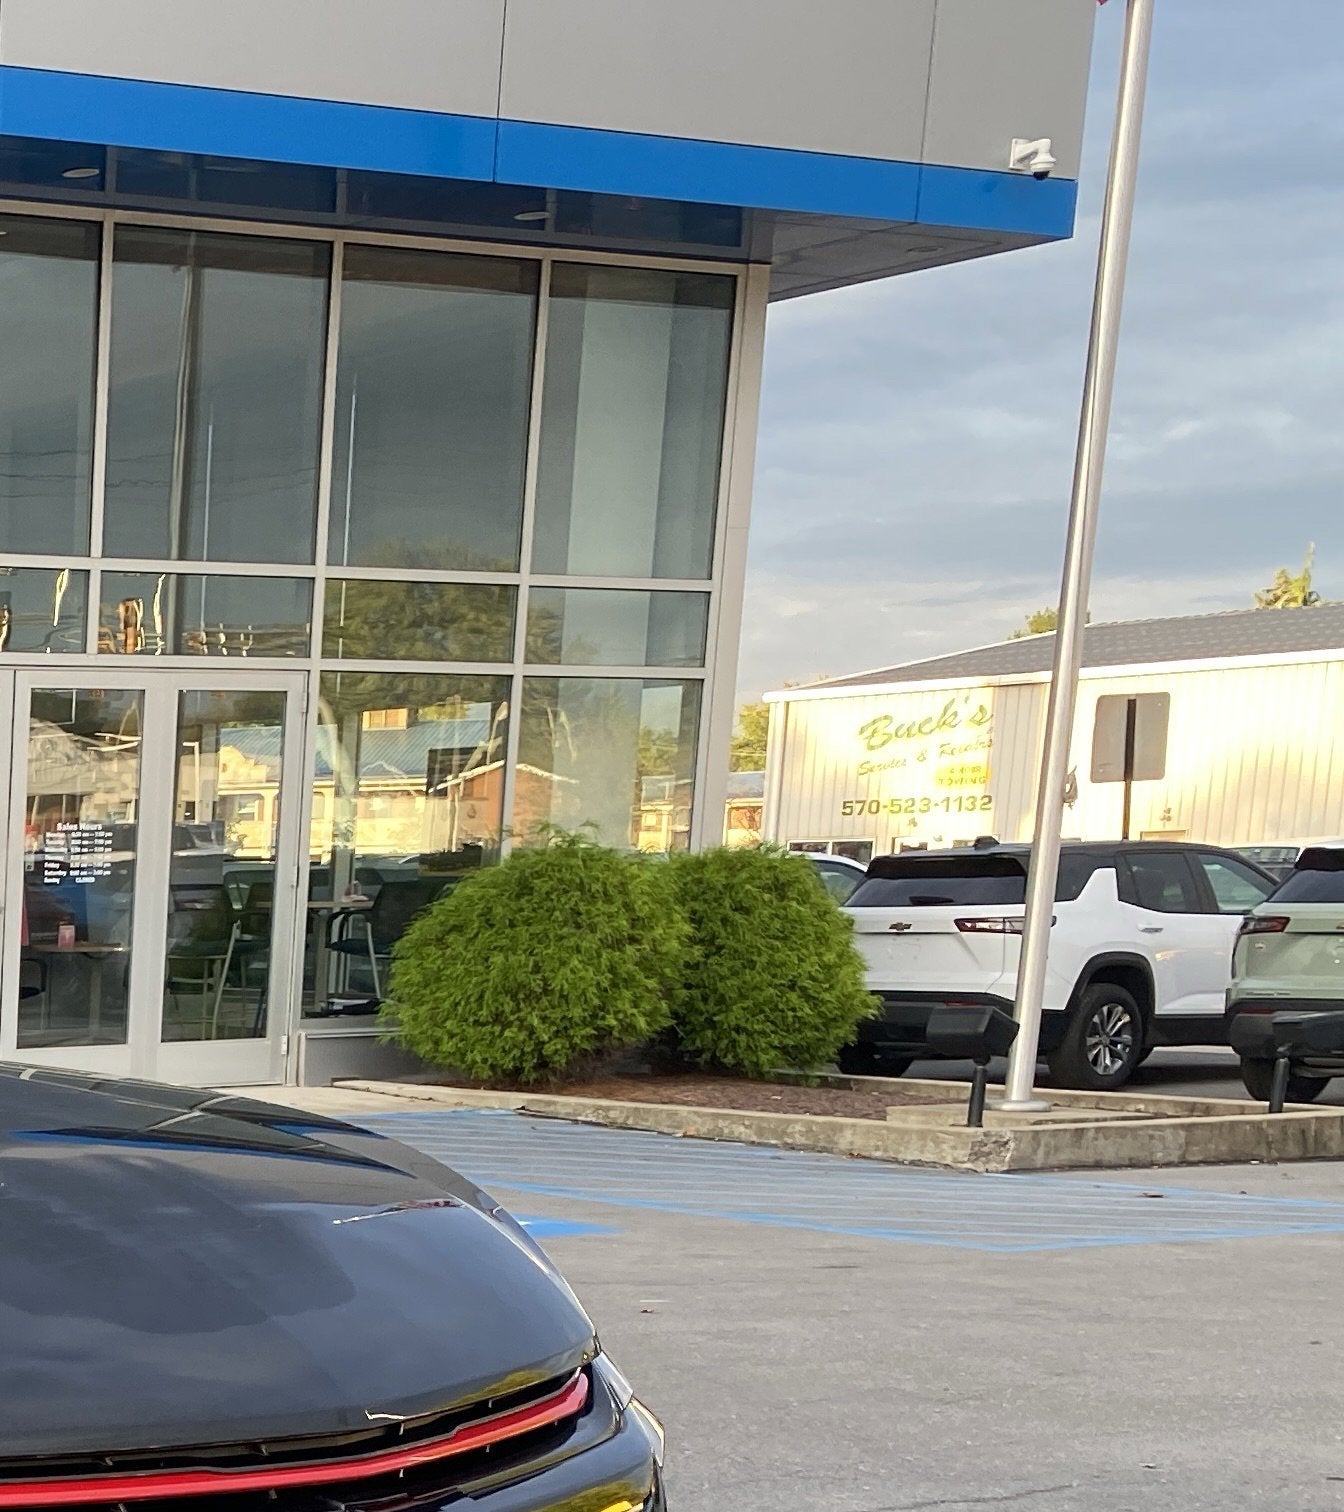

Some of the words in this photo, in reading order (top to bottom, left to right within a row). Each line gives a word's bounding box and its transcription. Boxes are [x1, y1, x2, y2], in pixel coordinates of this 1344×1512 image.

[859, 696, 994, 750] Buck's
[56, 822, 78, 831] Sales
[79, 823, 103, 831] Hours
